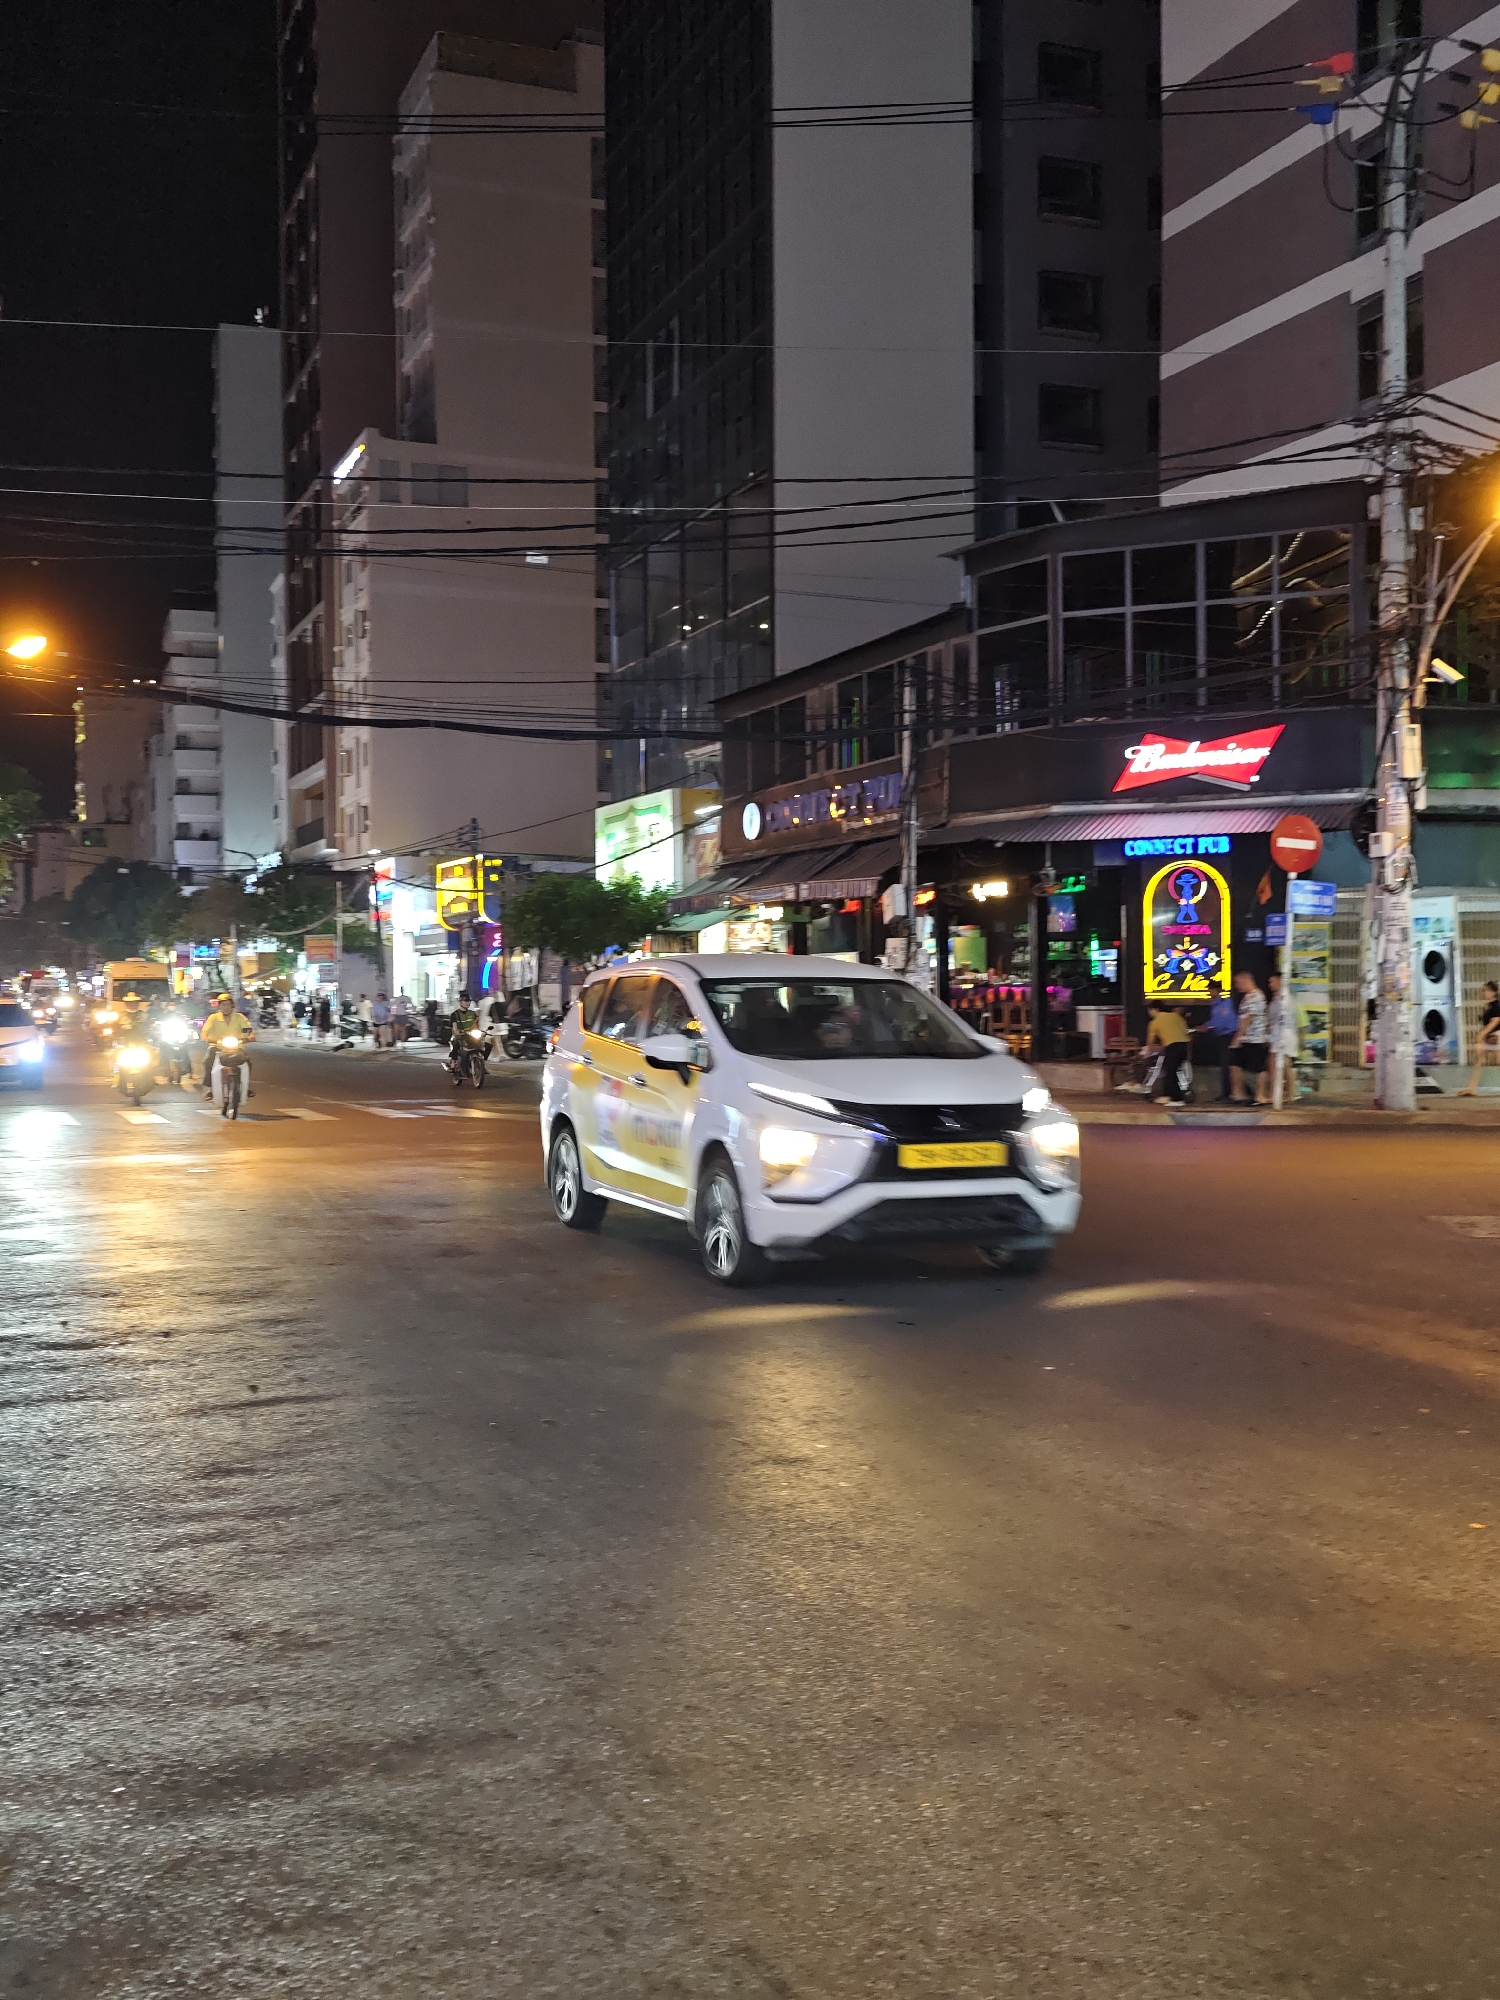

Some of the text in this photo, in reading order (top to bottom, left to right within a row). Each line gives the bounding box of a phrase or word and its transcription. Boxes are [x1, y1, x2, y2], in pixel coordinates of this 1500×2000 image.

[1125, 741, 1270, 773] Budweiser
[1124, 836, 1230, 856] CONNECT PUB
